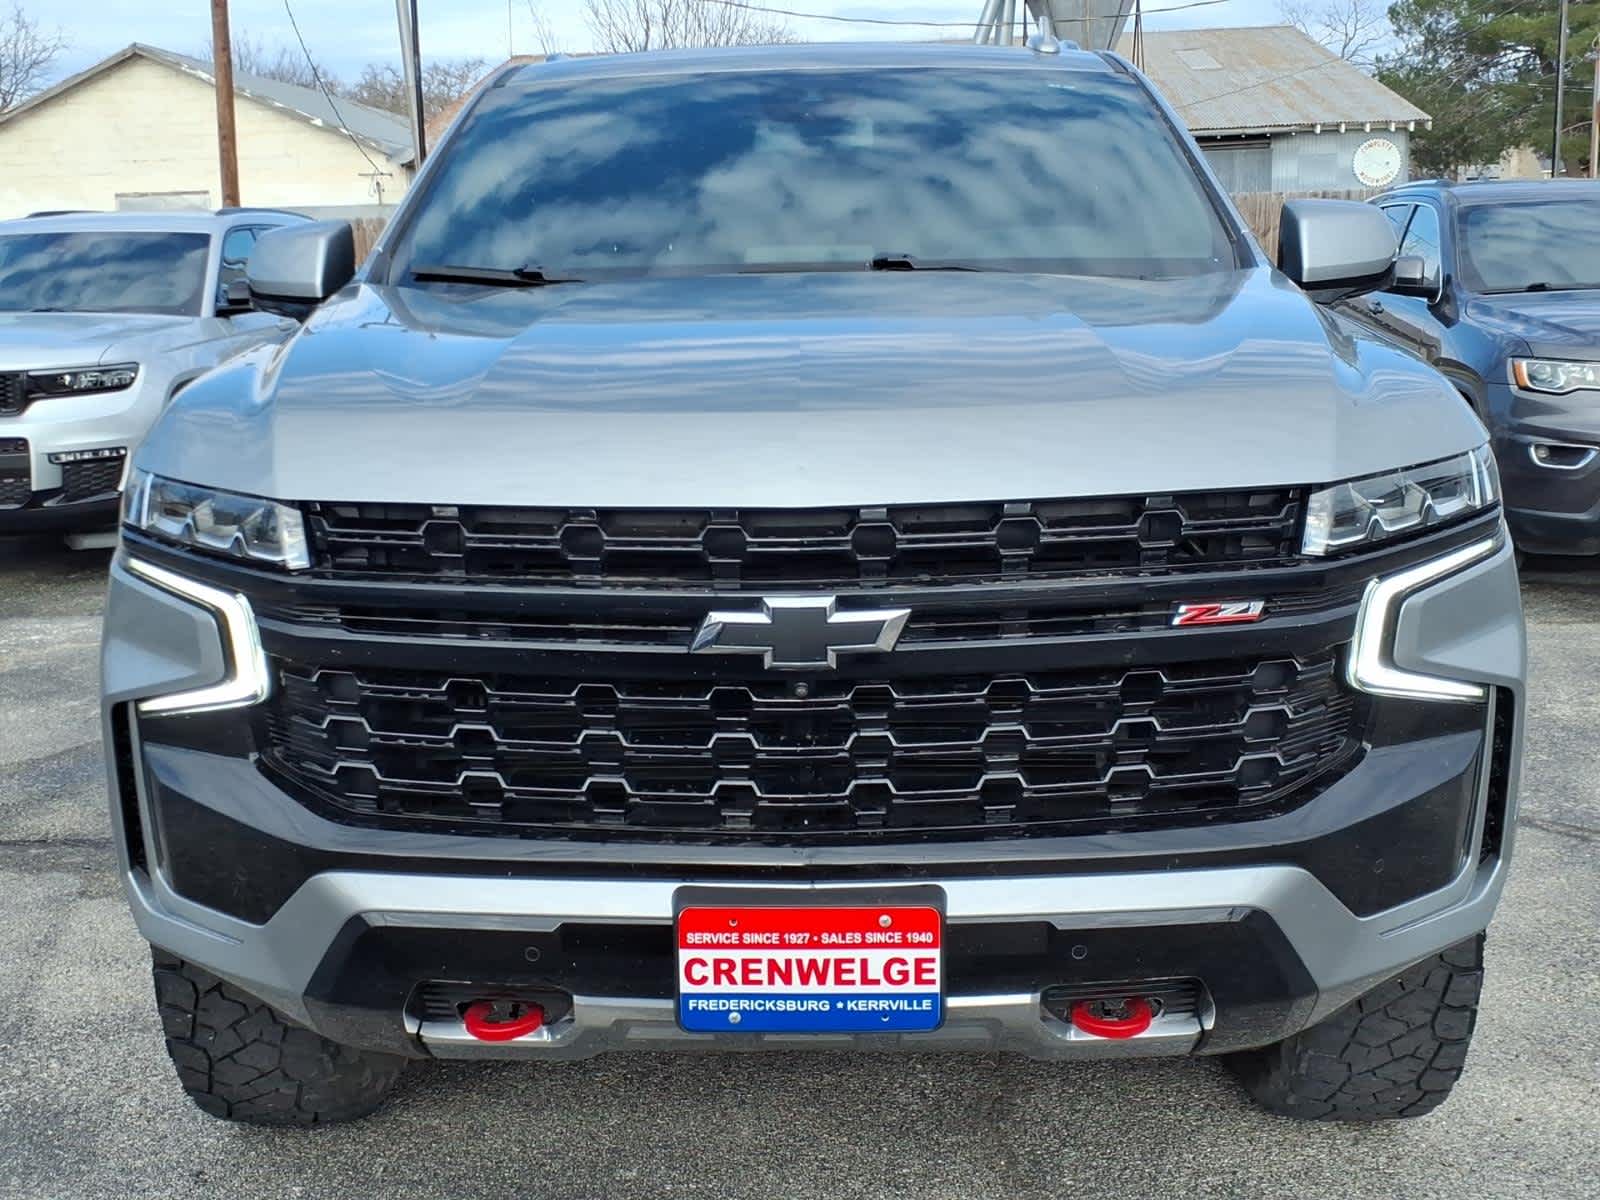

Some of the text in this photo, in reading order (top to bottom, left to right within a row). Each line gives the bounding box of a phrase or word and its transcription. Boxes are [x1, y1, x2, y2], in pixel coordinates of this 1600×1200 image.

[1172, 601, 1265, 625] Z71
[686, 932, 933, 945] SERVICE SINCE 1927 SALES SINCE 1940
[683, 957, 937, 986] CRENWELGE
[688, 999, 933, 1012] FREDERICKSBURG KERRVILLE
